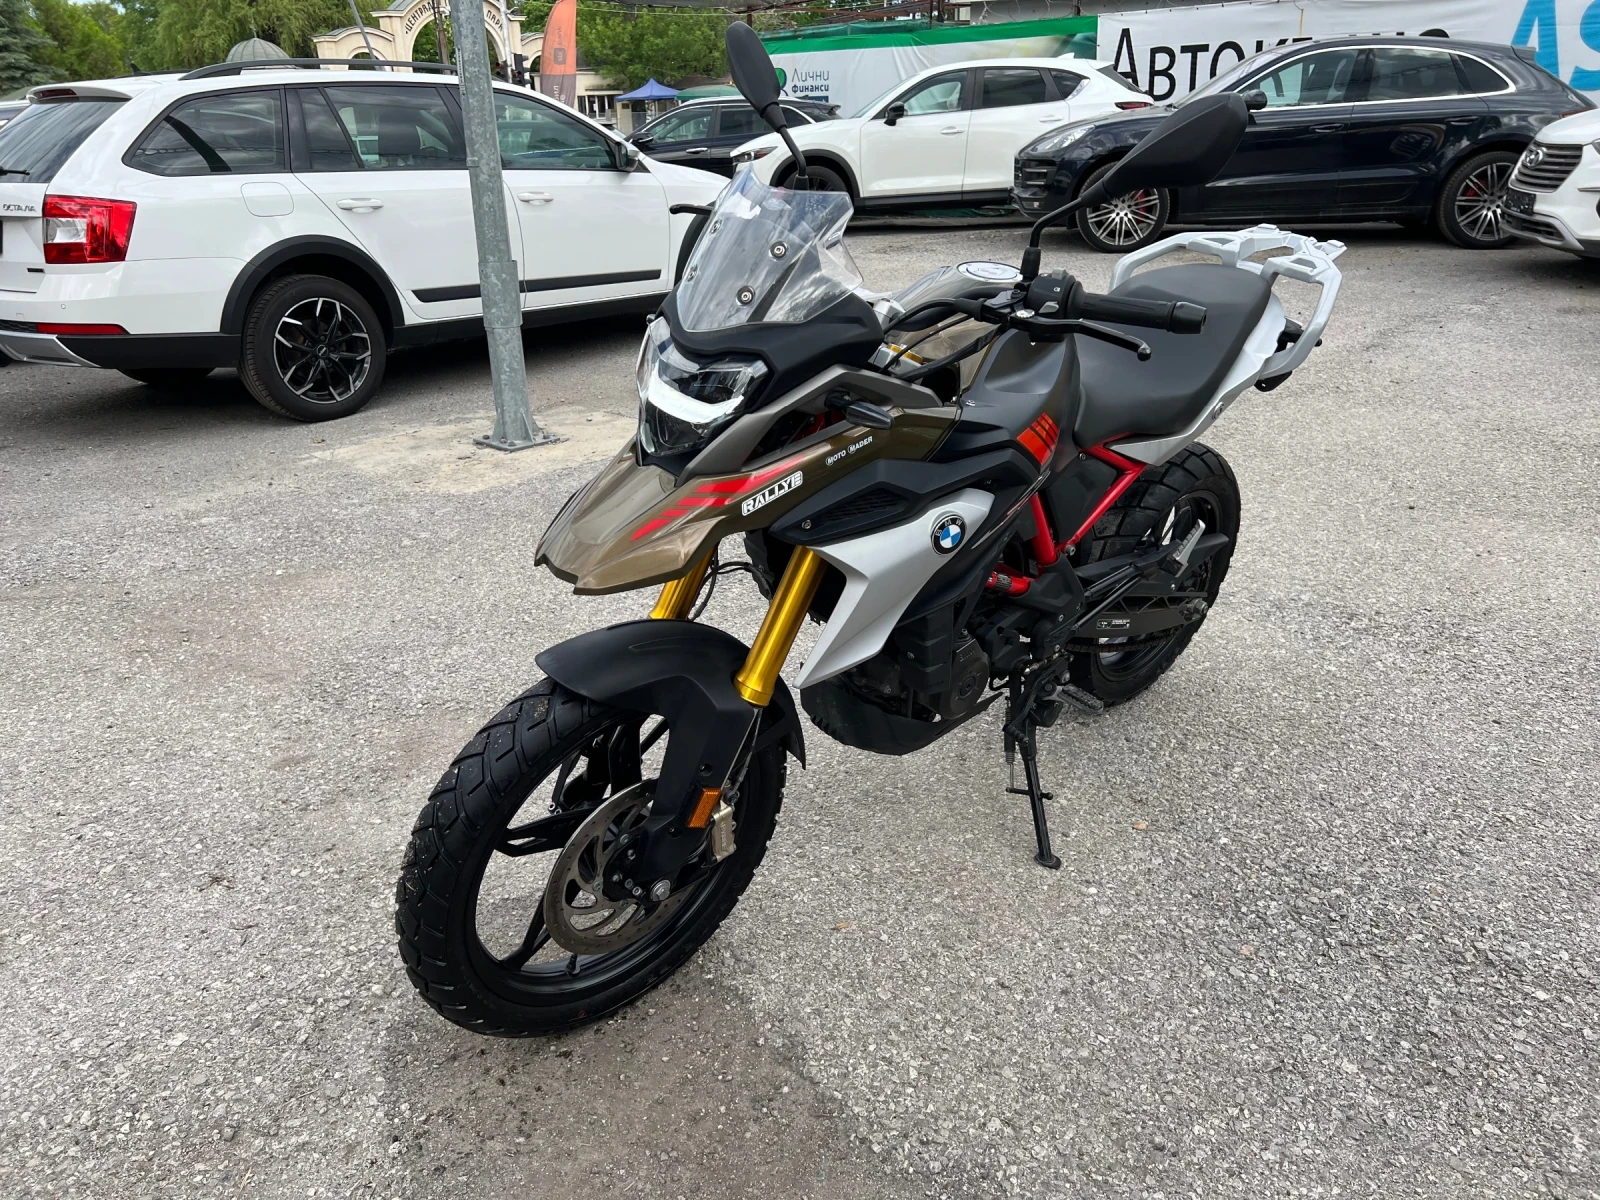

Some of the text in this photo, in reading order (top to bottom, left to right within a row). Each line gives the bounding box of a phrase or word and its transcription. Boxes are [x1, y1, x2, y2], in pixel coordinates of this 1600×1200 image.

[791, 68, 830, 82] Лични
[825, 435, 874, 466] MOTO MADER
[934, 517, 964, 537] BMW
